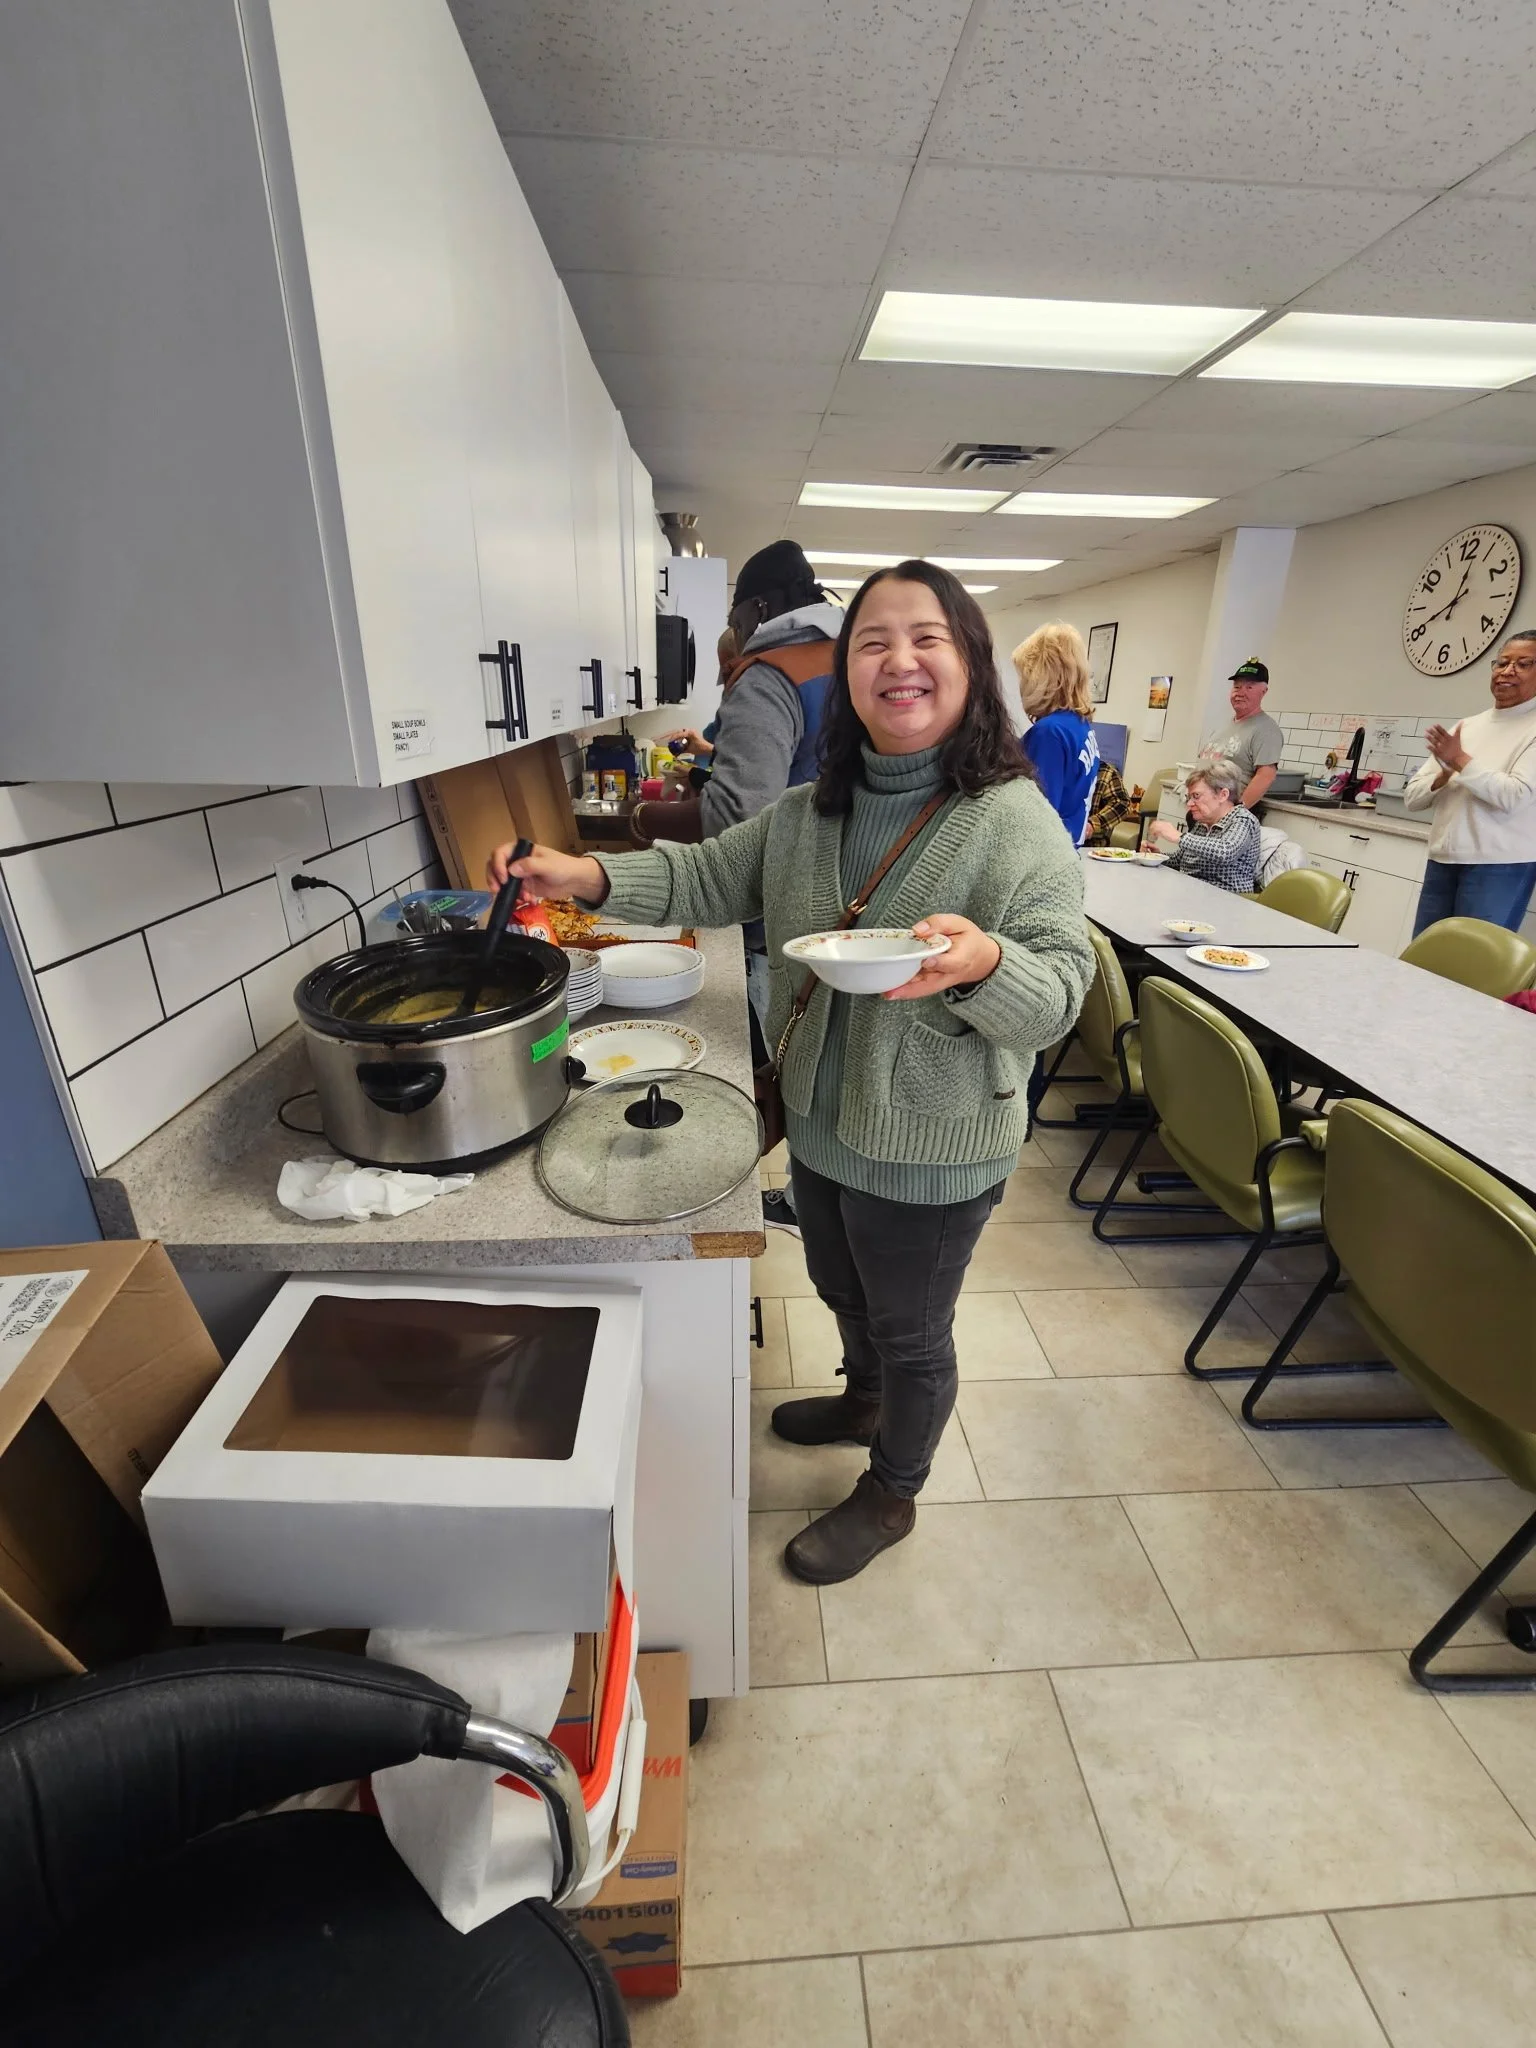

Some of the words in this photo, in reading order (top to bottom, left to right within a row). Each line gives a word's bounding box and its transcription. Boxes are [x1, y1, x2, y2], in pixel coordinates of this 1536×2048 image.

[1459, 537, 1481, 562] 12
[1489, 559, 1508, 582] 2
[1421, 569, 1441, 594] 10
[1411, 623, 1427, 642] 8
[1480, 614, 1495, 633] 4
[1437, 643, 1450, 664] 6
[391, 721, 404, 729] SMALL
[404, 720, 413, 728] SOUP
[414, 719, 426, 727] BOWLS
[393, 732, 405, 740] SMALL
[406, 730, 418, 739] PLATES
